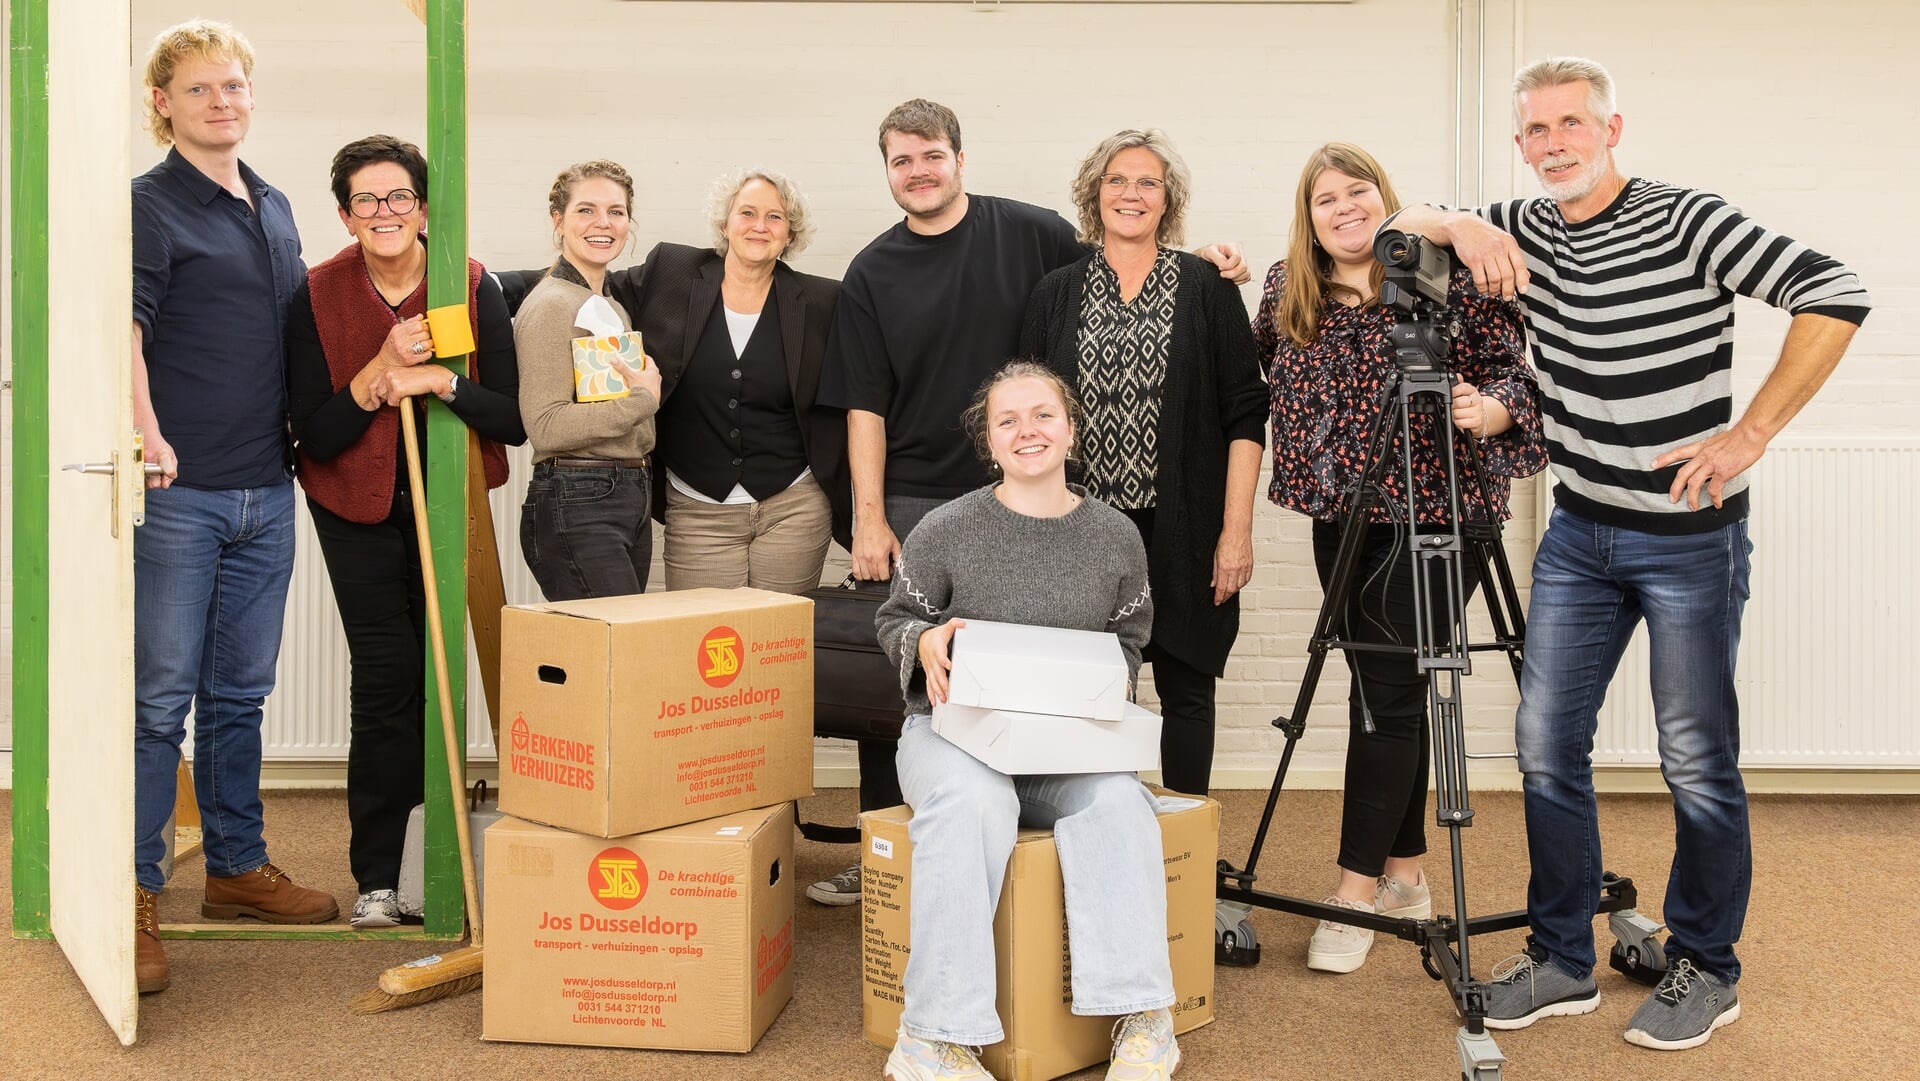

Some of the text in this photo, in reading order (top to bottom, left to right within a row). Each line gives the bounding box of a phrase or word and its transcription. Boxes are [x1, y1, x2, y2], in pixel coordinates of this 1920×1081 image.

[751, 636, 806, 653] De krachtige
[760, 650, 808, 665] combinatie
[657, 686, 781, 720] Jos Dusseldorp
[653, 725, 693, 739] transport
[700, 715, 752, 731] verhuizingen
[759, 708, 784, 721] opslag
[531, 733, 595, 766] ERKENDE
[678, 746, 765, 770] www.josdusseldorp.nl
[511, 753, 595, 791] VERHUIZERS
[677, 758, 766, 783] info@josdusseldorp.nl
[689, 771, 753, 792] 0031 544 371210
[684, 783, 757, 805] Lichtenvoorde NL
[1183, 851, 1191, 860] BV
[658, 870, 735, 885] De krachtige
[863, 865, 904, 883] Buying company
[863, 875, 898, 890] Order Number
[670, 886, 738, 898] combinatie
[864, 885, 891, 899] Style Name
[864, 895, 901, 911] Article Number
[864, 905, 877, 915] Color
[538, 911, 698, 941] Jos Dusseldorp
[864, 915, 874, 924] Size
[864, 925, 884, 938] Quantity
[534, 938, 582, 951] transport
[591, 941, 658, 955] verhuizingen
[669, 945, 703, 957] opslag
[864, 934, 880, 946] Carton
[864, 944, 891, 958] Destination
[874, 958, 891, 969] Weight
[865, 965, 898, 981] Gross Weight
[563, 977, 676, 991] www.josdusseldorp.nl
[865, 974, 897, 990] Measurement
[562, 988, 677, 1003] info@josdusseldorp.nl
[873, 989, 888, 1000] MADE
[578, 1002, 661, 1014] 0031 544 371210
[572, 1014, 666, 1028] Lichtenvoorde NL
